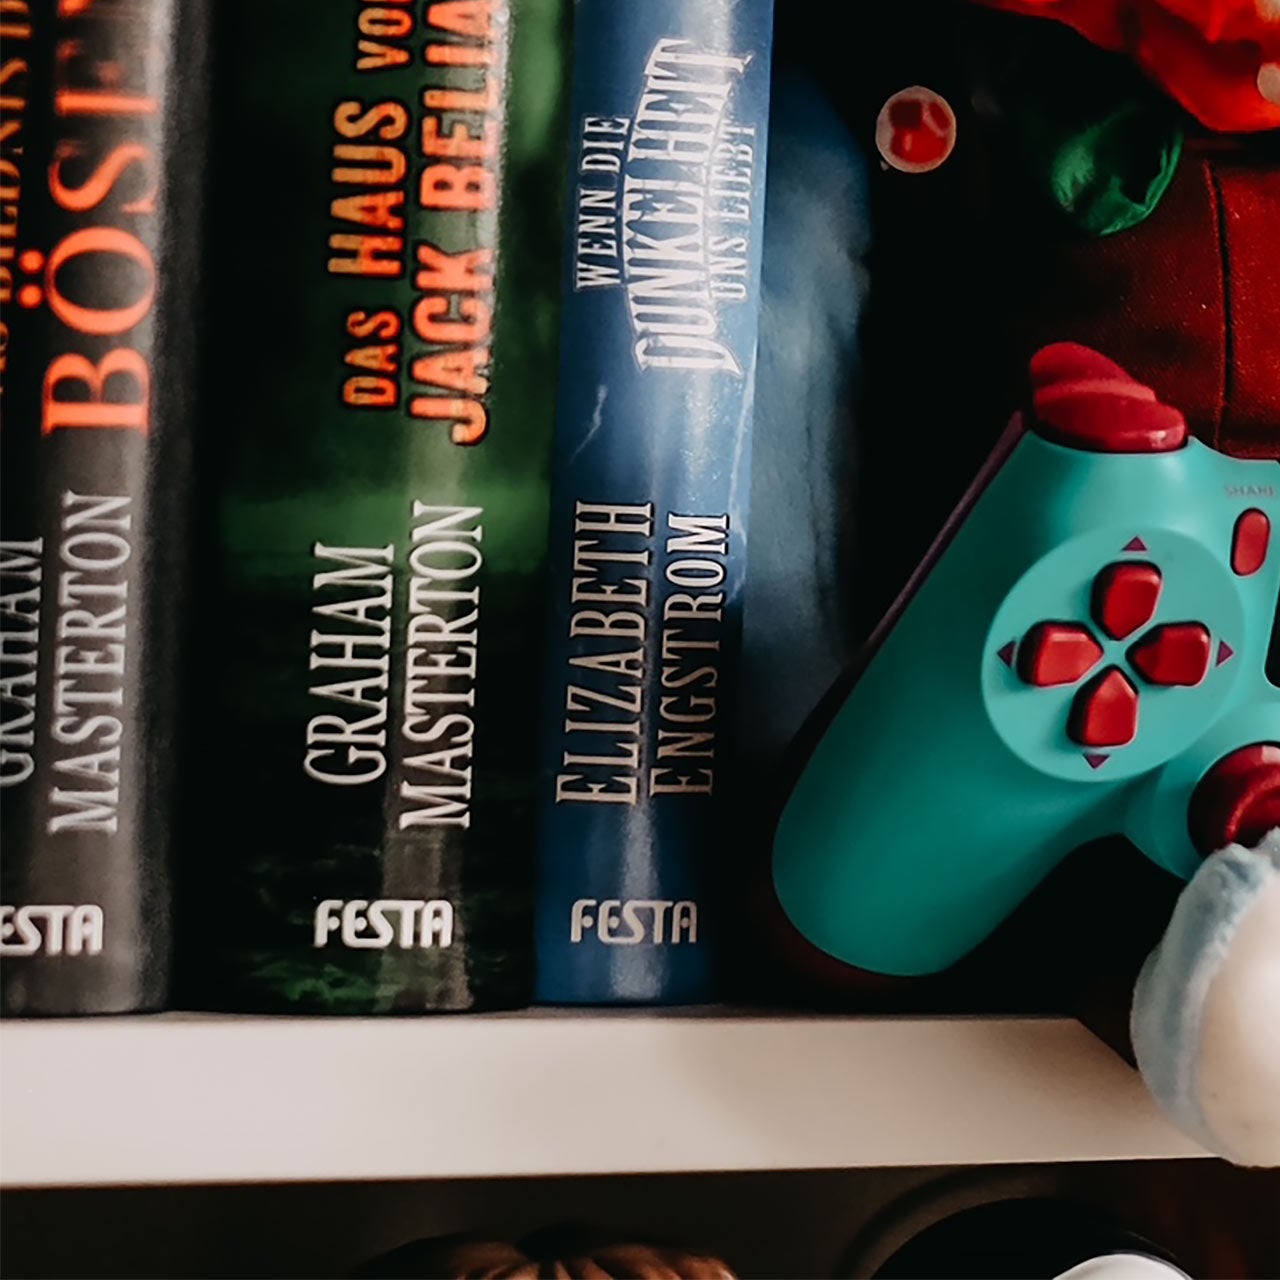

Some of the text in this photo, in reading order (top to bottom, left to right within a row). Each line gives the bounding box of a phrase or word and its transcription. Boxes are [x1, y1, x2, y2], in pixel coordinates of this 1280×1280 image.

[328, 100, 409, 276] HAUS
[575, 115, 630, 290] WENN DIE
[622, 35, 755, 377] DUNKELHEIT
[708, 234, 750, 302] UNS
[342, 310, 400, 408] DAS
[409, 242, 496, 447] JACK
[46, 489, 132, 836] MASTERTON
[302, 541, 395, 787] GRAHAM
[399, 499, 484, 832] MASTERTON
[555, 498, 655, 806] ELIZABETH
[649, 511, 731, 798] ENGSTROM
[313, 898, 455, 949] FESTA
[569, 898, 698, 945] FESTA
